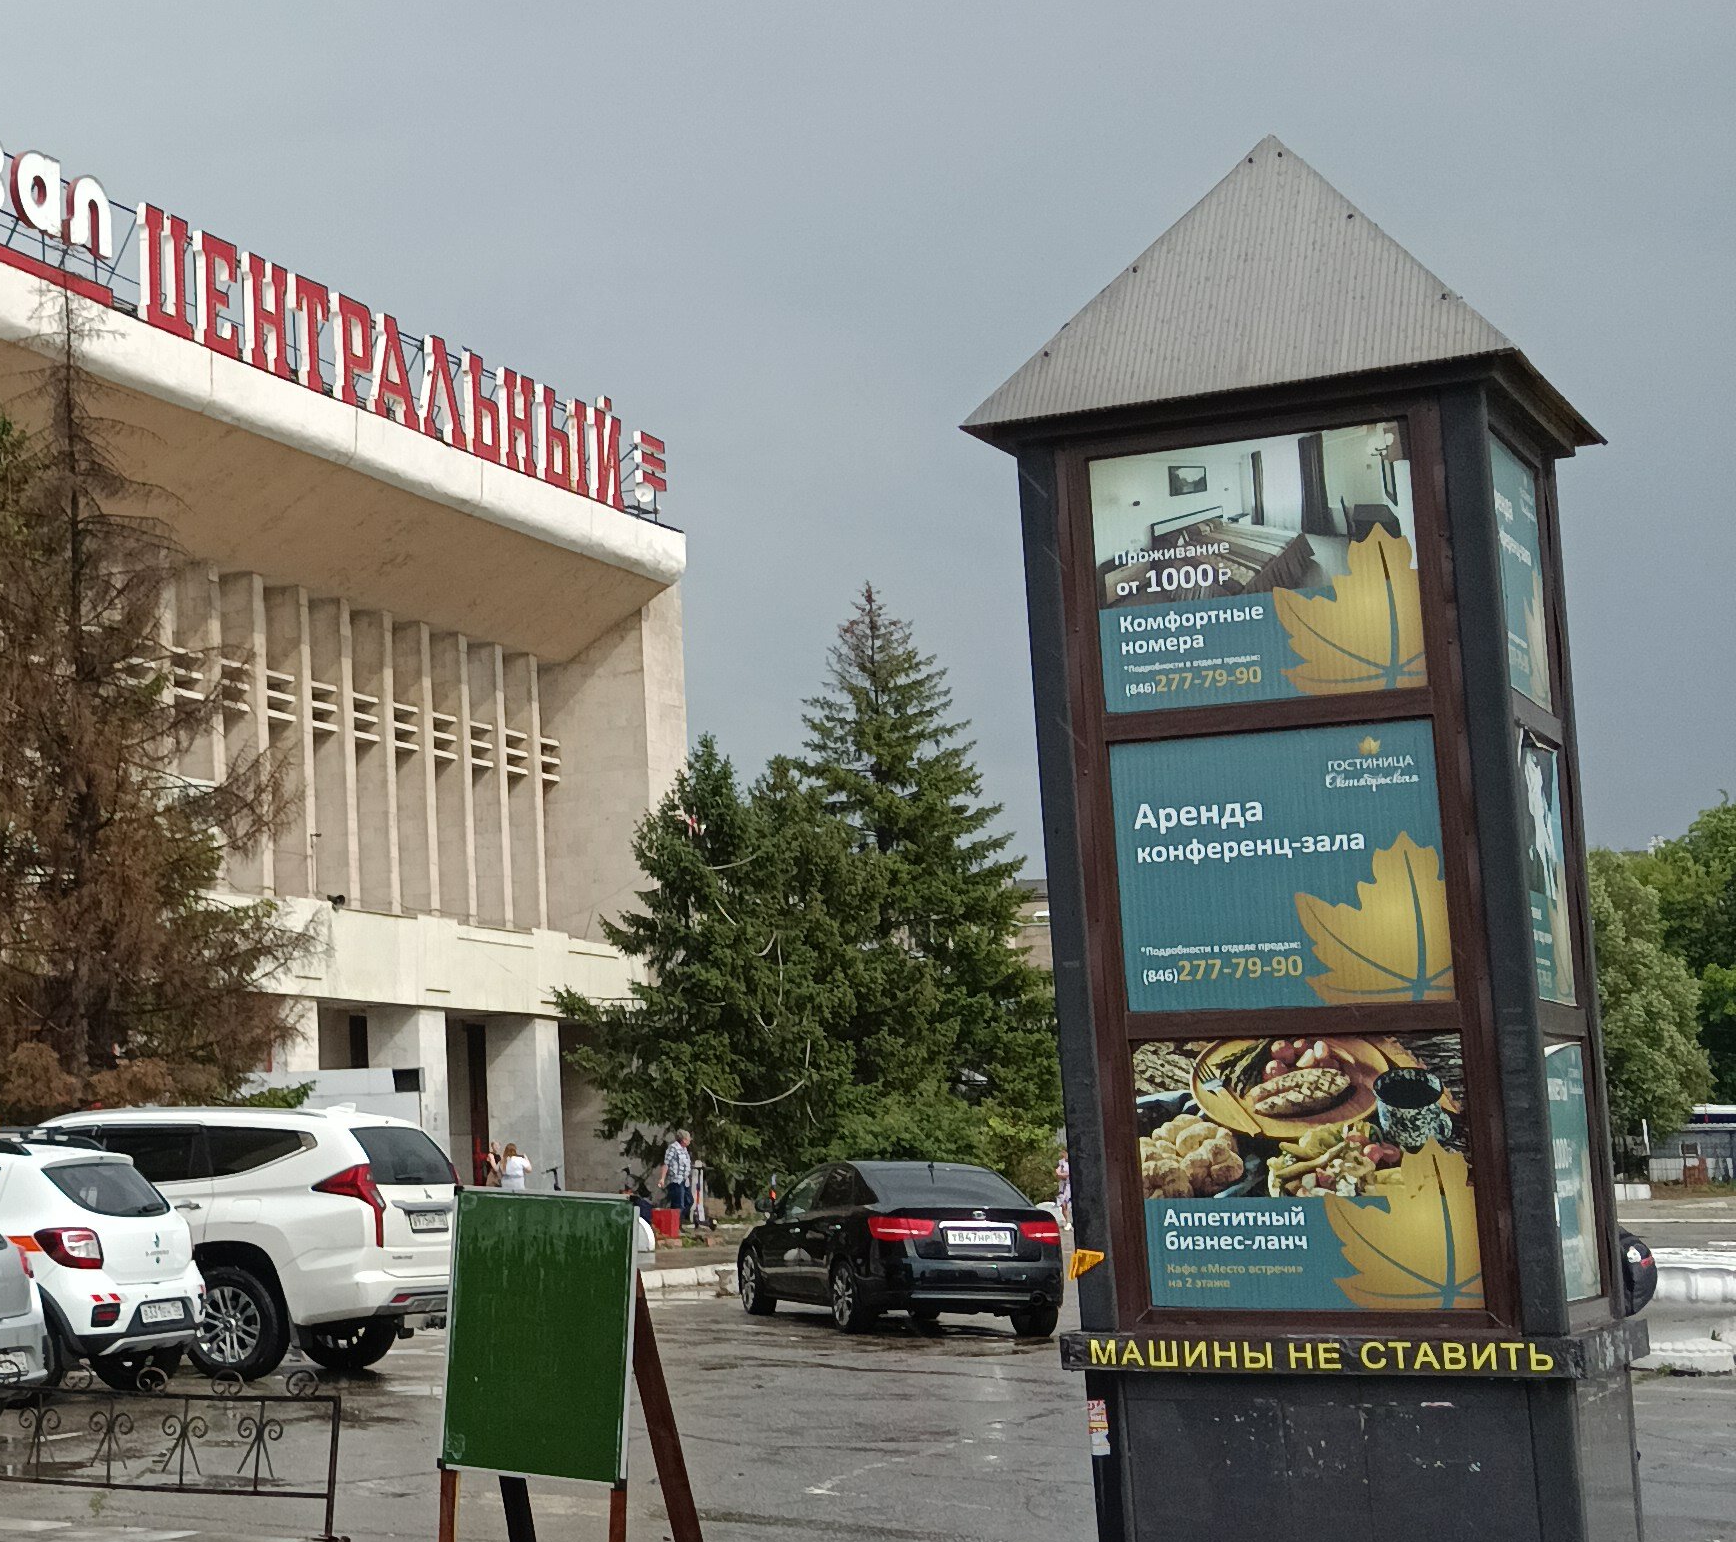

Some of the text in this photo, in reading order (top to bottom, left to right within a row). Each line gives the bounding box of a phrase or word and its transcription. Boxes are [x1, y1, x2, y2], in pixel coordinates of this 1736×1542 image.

[136, 201, 625, 511] ЦЕНТРАЛЬНЫЙ
[1114, 541, 1230, 567] Проживание
[1116, 581, 1140, 596] от
[1145, 563, 1214, 593] 1000
[1119, 605, 1264, 633] Комфортные
[1121, 634, 1205, 655] номера
[1327, 754, 1414, 772] ГОСТИНИЦА
[1134, 800, 1263, 834] Аренда
[1137, 831, 1365, 865] конференц-зала
[1164, 1206, 1305, 1227] Аппетитный
[1165, 1230, 1308, 1250] бизнес-ланч
[1167, 1263, 1198, 1275] Кафе
[1200, 1263, 1245, 1274] «Место
[1168, 1277, 1231, 1288] на 2 этаже
[1088, 1338, 1555, 1372] МАШИНЫ НЕ СТАВИТЬ
